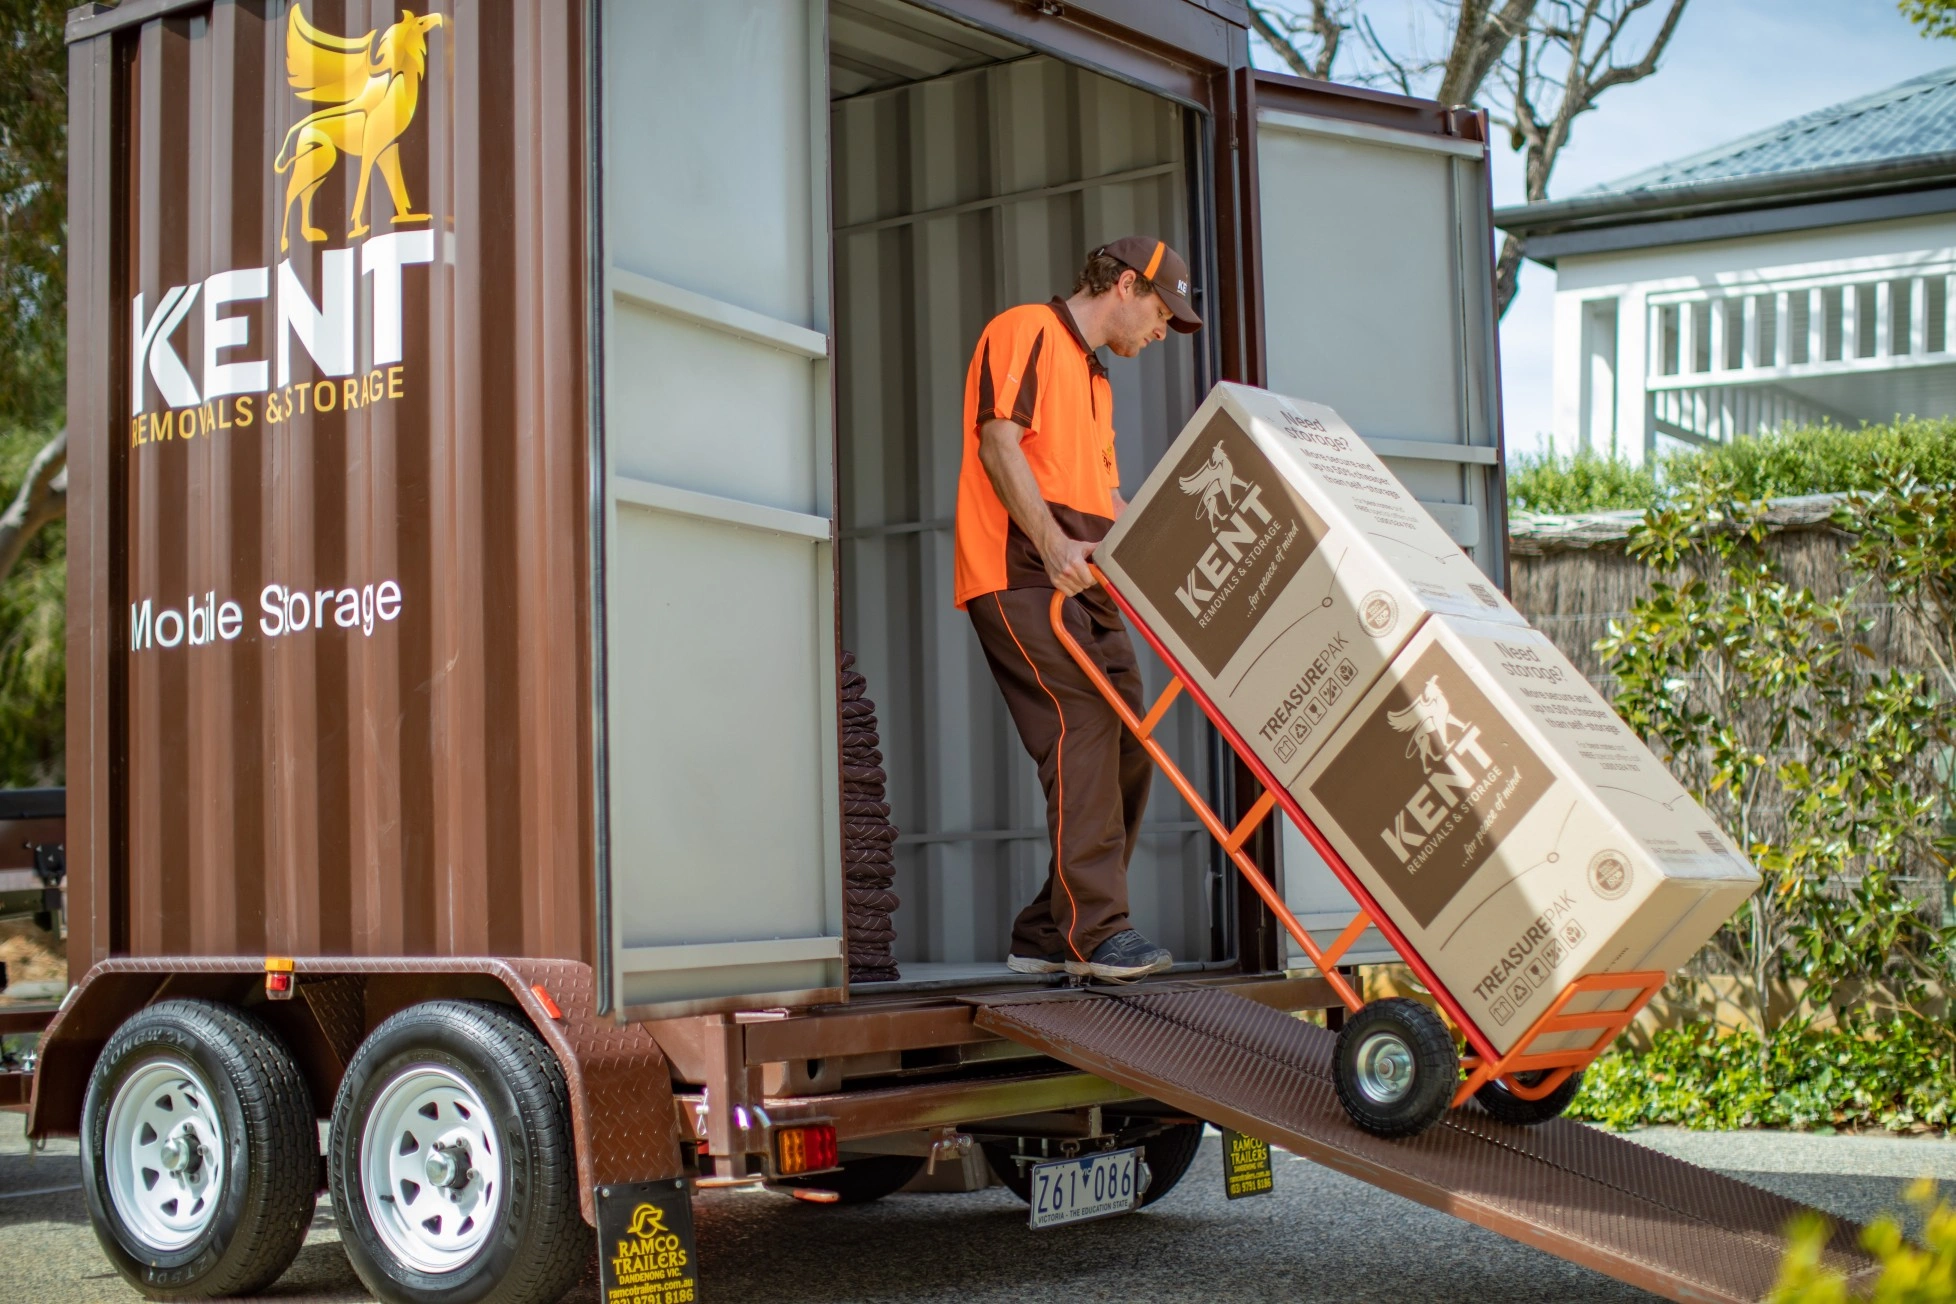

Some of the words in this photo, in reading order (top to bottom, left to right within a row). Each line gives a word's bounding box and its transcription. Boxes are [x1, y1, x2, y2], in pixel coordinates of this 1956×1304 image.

[132, 229, 435, 417] KENT
[132, 396, 254, 449] REMOVALS
[266, 392, 283, 424] &
[283, 366, 404, 422] STORAGE
[1280, 410, 1327, 432] Need
[1284, 426, 1352, 452] storage?
[1174, 485, 1272, 619] KENT
[1258, 561, 1278, 597] peace
[1275, 545, 1285, 565] of
[1281, 519, 1299, 553] mind
[1198, 576, 1240, 629] REMOVALS
[1238, 566, 1247, 577] &
[1245, 520, 1282, 565] STORAGE
[131, 591, 243, 652] Mobile
[259, 579, 402, 637] Storage
[1494, 641, 1540, 662] Need
[1258, 631, 1349, 742] TREASUREPAK
[1501, 661, 1567, 684] storage?
[1380, 725, 1493, 864] KENT
[1476, 809, 1498, 843] peace
[1495, 792, 1506, 811] of
[1501, 765, 1523, 797] mind
[1406, 821, 1454, 875] REMOVALS
[1453, 814, 1462, 822] &
[1461, 765, 1503, 814] STORAGE
[1472, 889, 1577, 1002] TREASUREPAK
[1230, 1148, 1267, 1166] TRAILERS
[1232, 1137, 1263, 1153] RAMCO
[1038, 1170, 1076, 1214] Z61
[1095, 1160, 1131, 1202] 086
[1038, 1211, 1064, 1223] VICTORIA
[1070, 1208, 1080, 1217] THE
[1082, 1203, 1111, 1215] EDUCATION
[1112, 1199, 1128, 1208] STATE
[613, 1250, 687, 1275] TRAILERS
[618, 1235, 679, 1258] RAMCO
[609, 1278, 694, 1300] ramcotrailers.com.au
[619, 1270, 666, 1285] DANDENONG
[667, 1267, 682, 1278] VIC.
[665, 1288, 694, 1304] 8186
